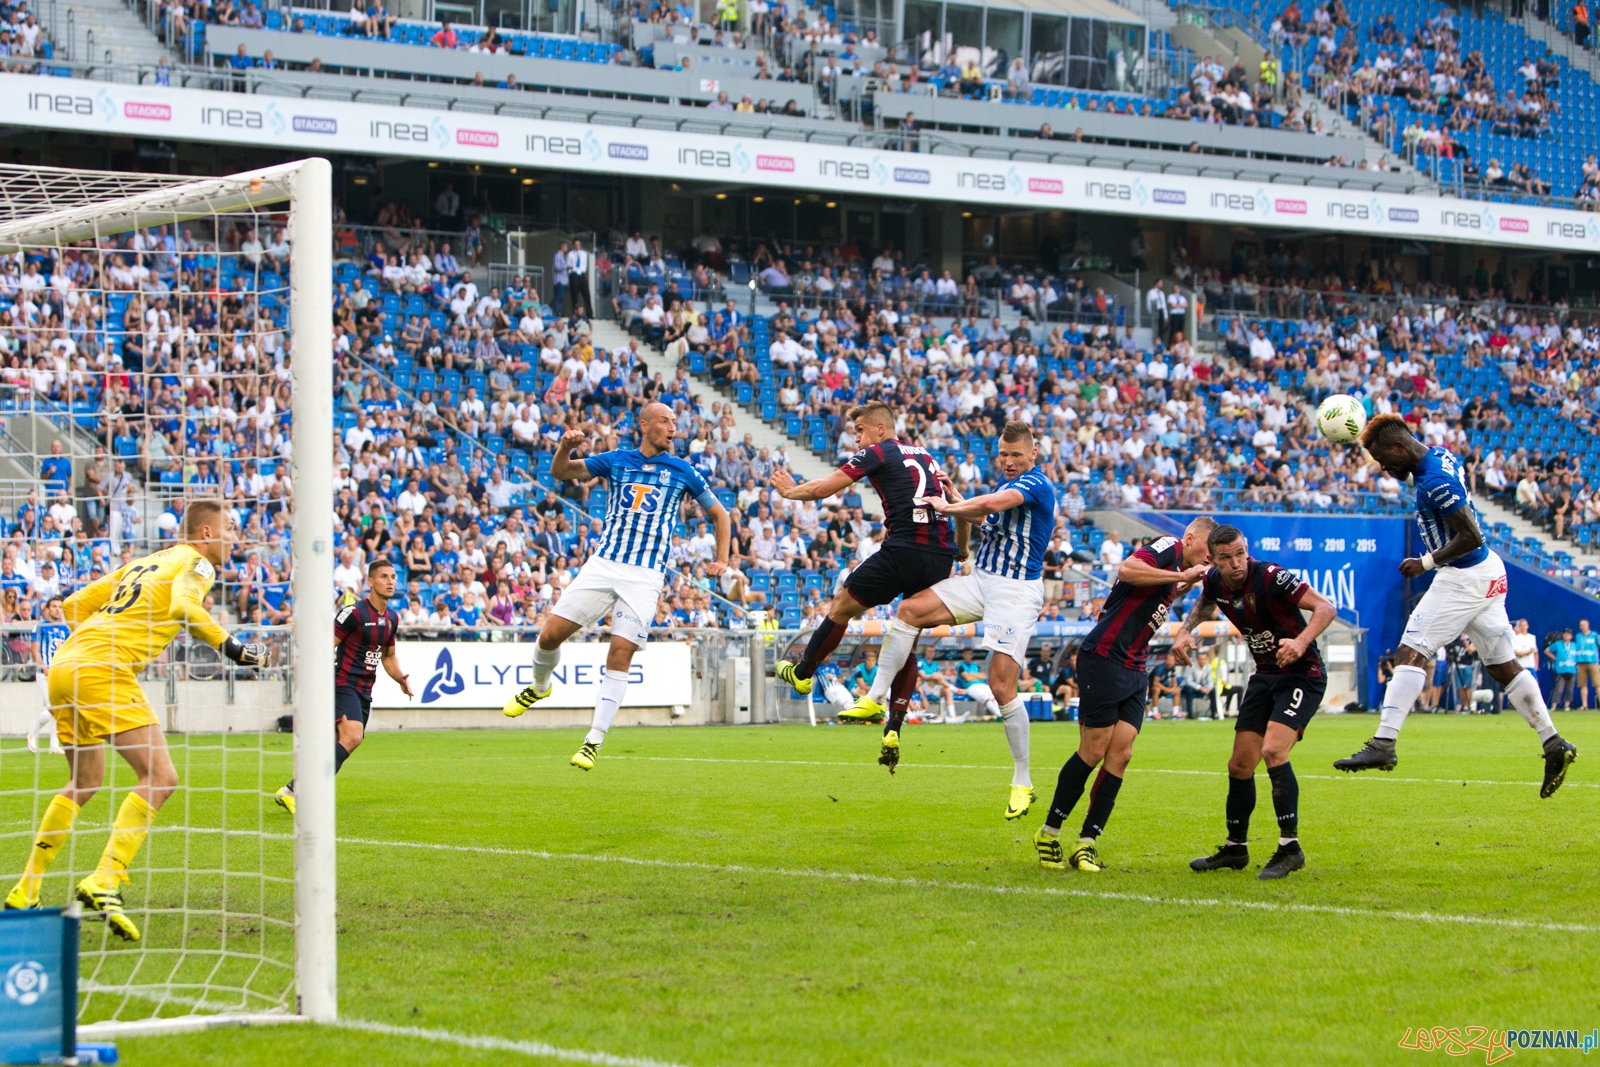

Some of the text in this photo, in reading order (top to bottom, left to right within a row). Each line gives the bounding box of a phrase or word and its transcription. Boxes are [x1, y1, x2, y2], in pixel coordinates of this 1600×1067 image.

[126, 103, 170, 119] STADION
[294, 117, 336, 133] STADION
[458, 131, 498, 147] STADION
[609, 144, 647, 159] STADION
[620, 483, 661, 514] STS
[1260, 537, 1377, 552] 1992 1993 2010 2015
[1290, 688, 1304, 709] 9
